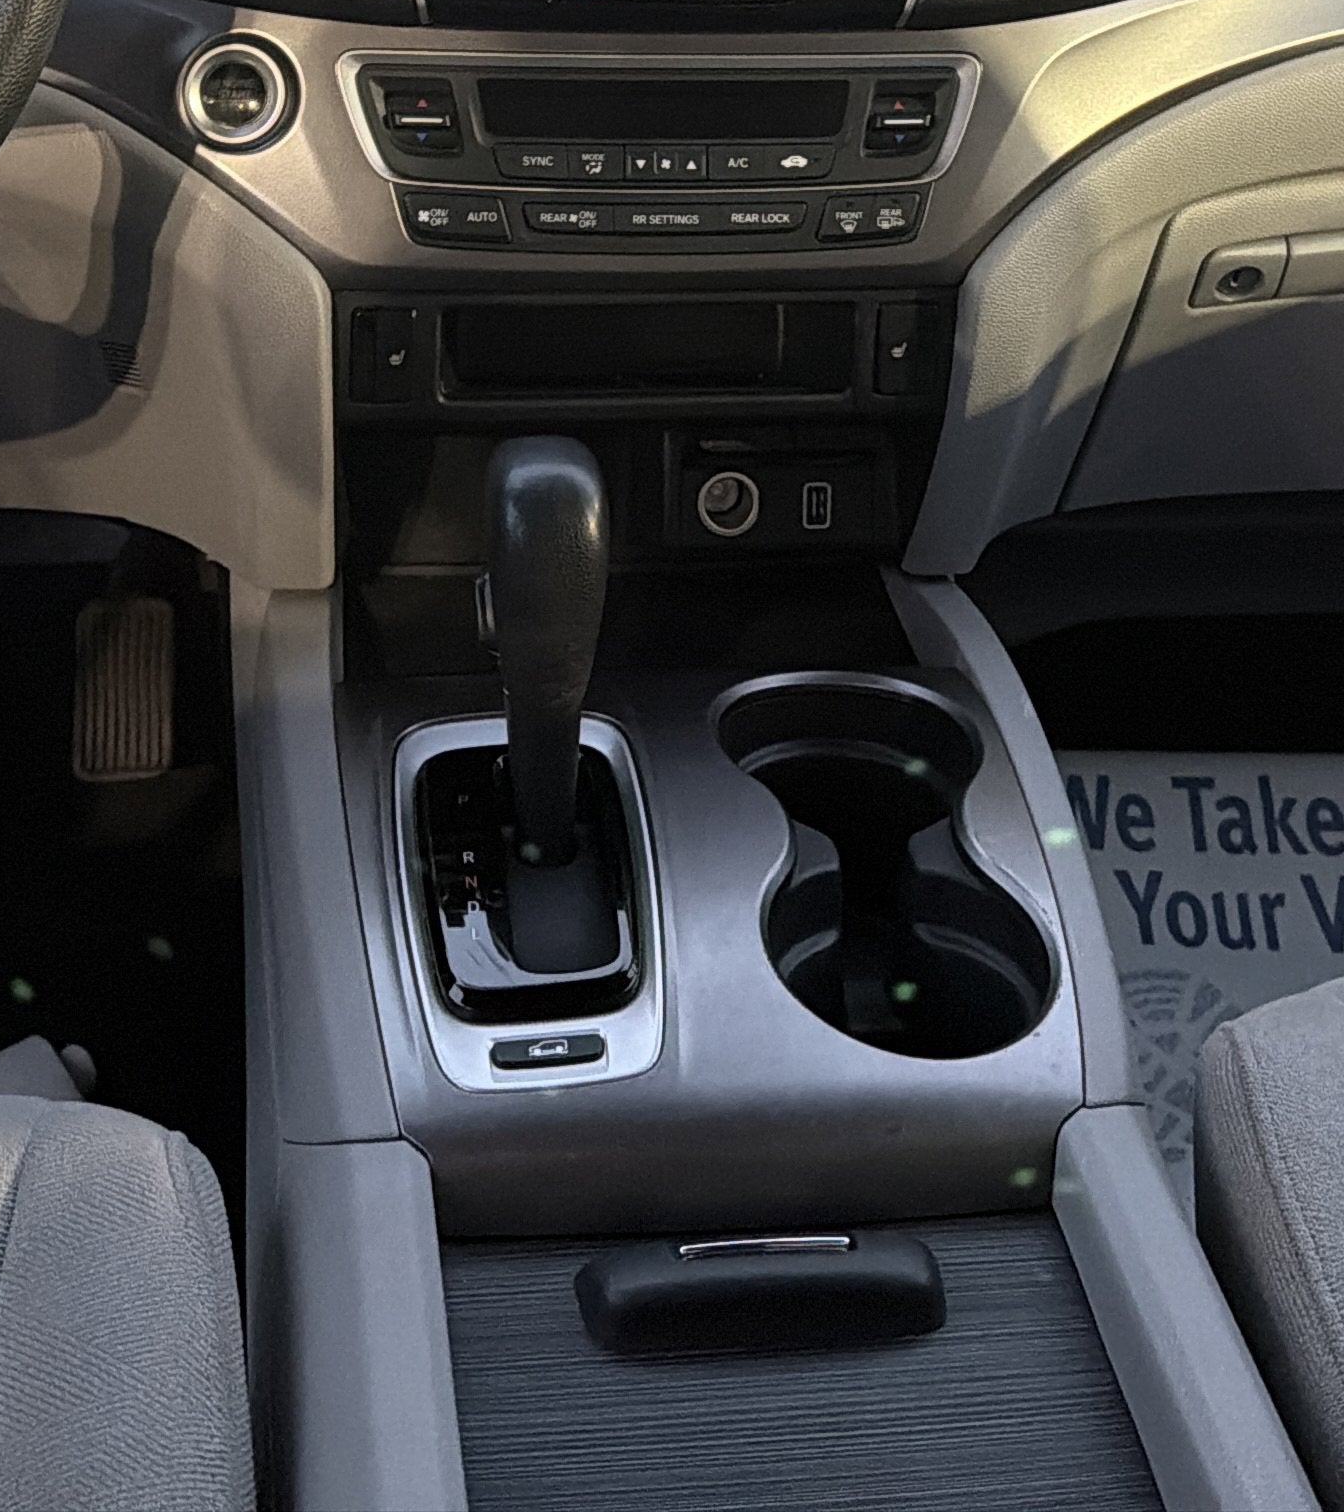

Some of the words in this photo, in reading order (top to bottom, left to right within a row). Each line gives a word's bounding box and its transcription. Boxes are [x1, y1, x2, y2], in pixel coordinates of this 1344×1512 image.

[522, 155, 554, 167] SYNC
[581, 153, 605, 161] MODE
[728, 157, 749, 169] A/C
[467, 211, 498, 223] AUTO
[540, 213, 567, 223] REAR
[731, 213, 759, 223] REAR
[762, 213, 790, 224] LOCK
[835, 211, 863, 220] FRONT
[880, 208, 902, 217] REAR
[633, 215, 647, 225] RR
[649, 215, 699, 225] SETTINGS
[462, 851, 475, 864] R
[465, 875, 478, 889] N
[467, 900, 480, 913] D
[1114, 868, 1285, 950] Your
